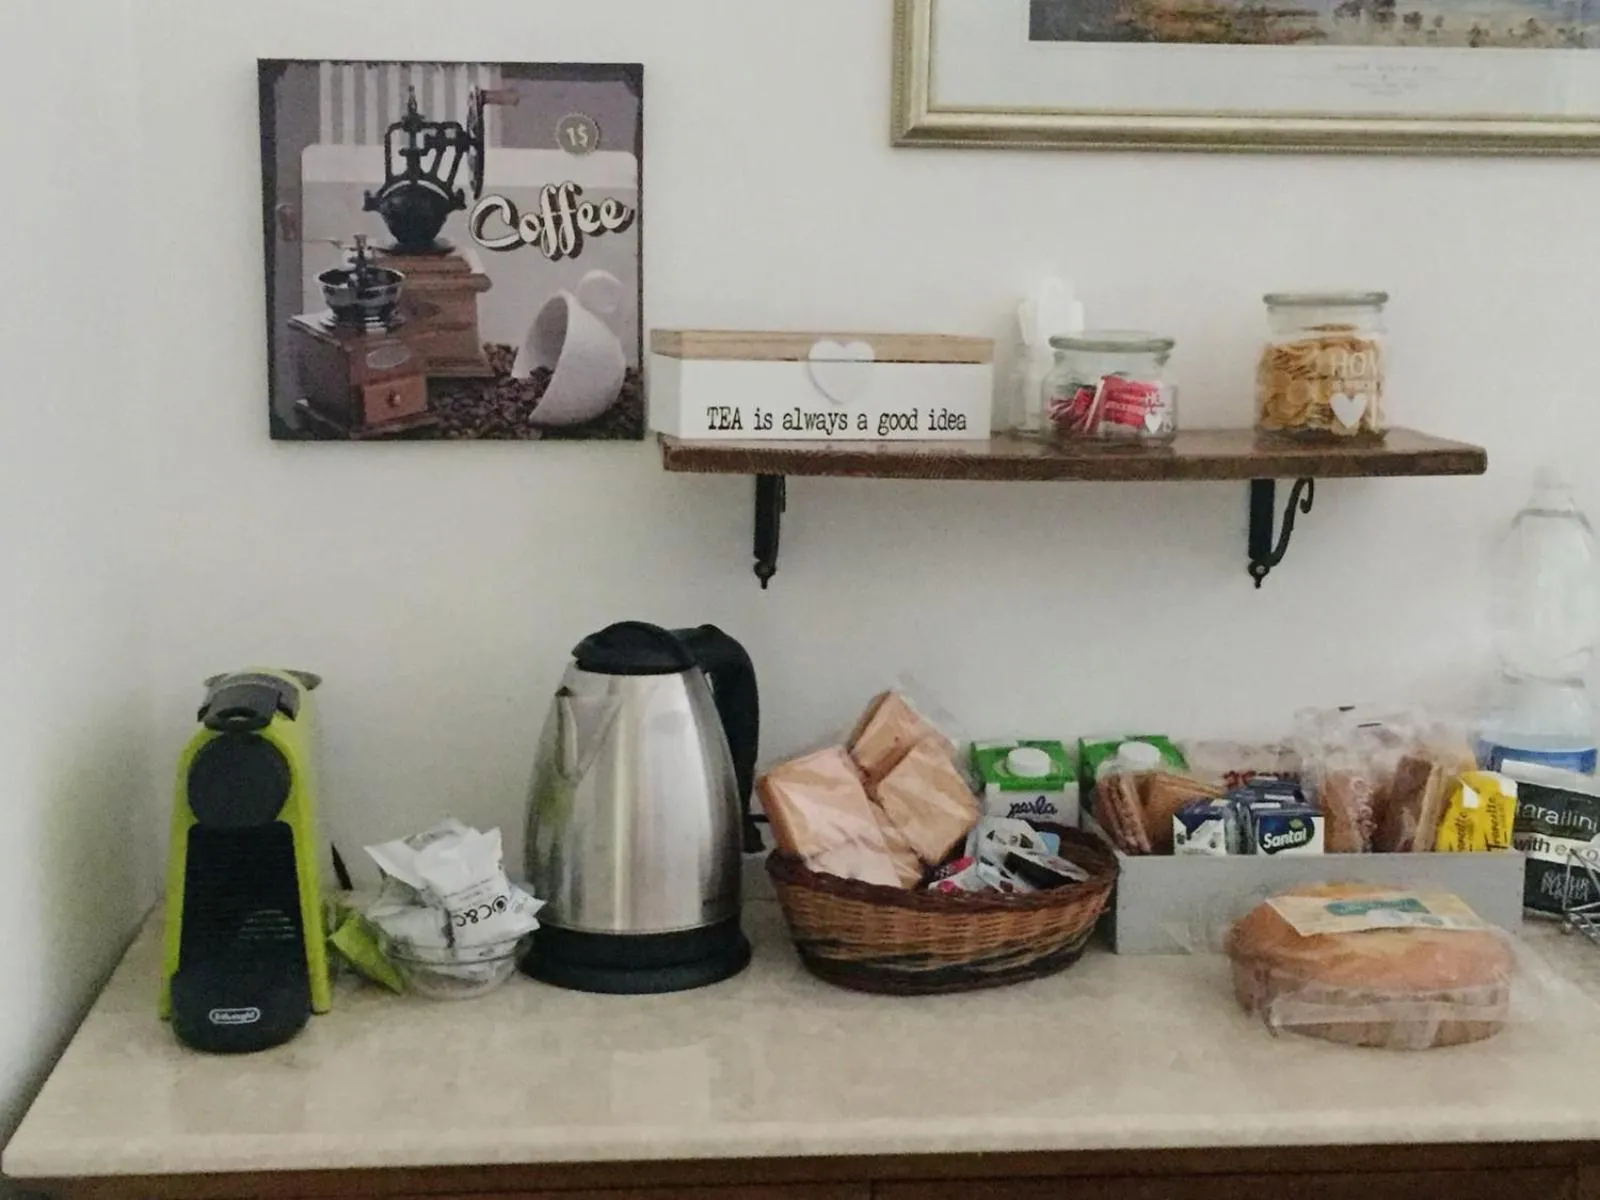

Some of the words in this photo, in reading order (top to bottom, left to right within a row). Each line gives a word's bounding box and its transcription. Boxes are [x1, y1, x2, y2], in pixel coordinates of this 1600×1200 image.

[469, 180, 635, 261] Coffee
[706, 406, 744, 431] TEA
[753, 407, 773, 431] is
[782, 407, 848, 436] always
[856, 412, 868, 431] a
[877, 408, 919, 436] good
[927, 408, 967, 431] idea
[1263, 827, 1307, 849] Santal
